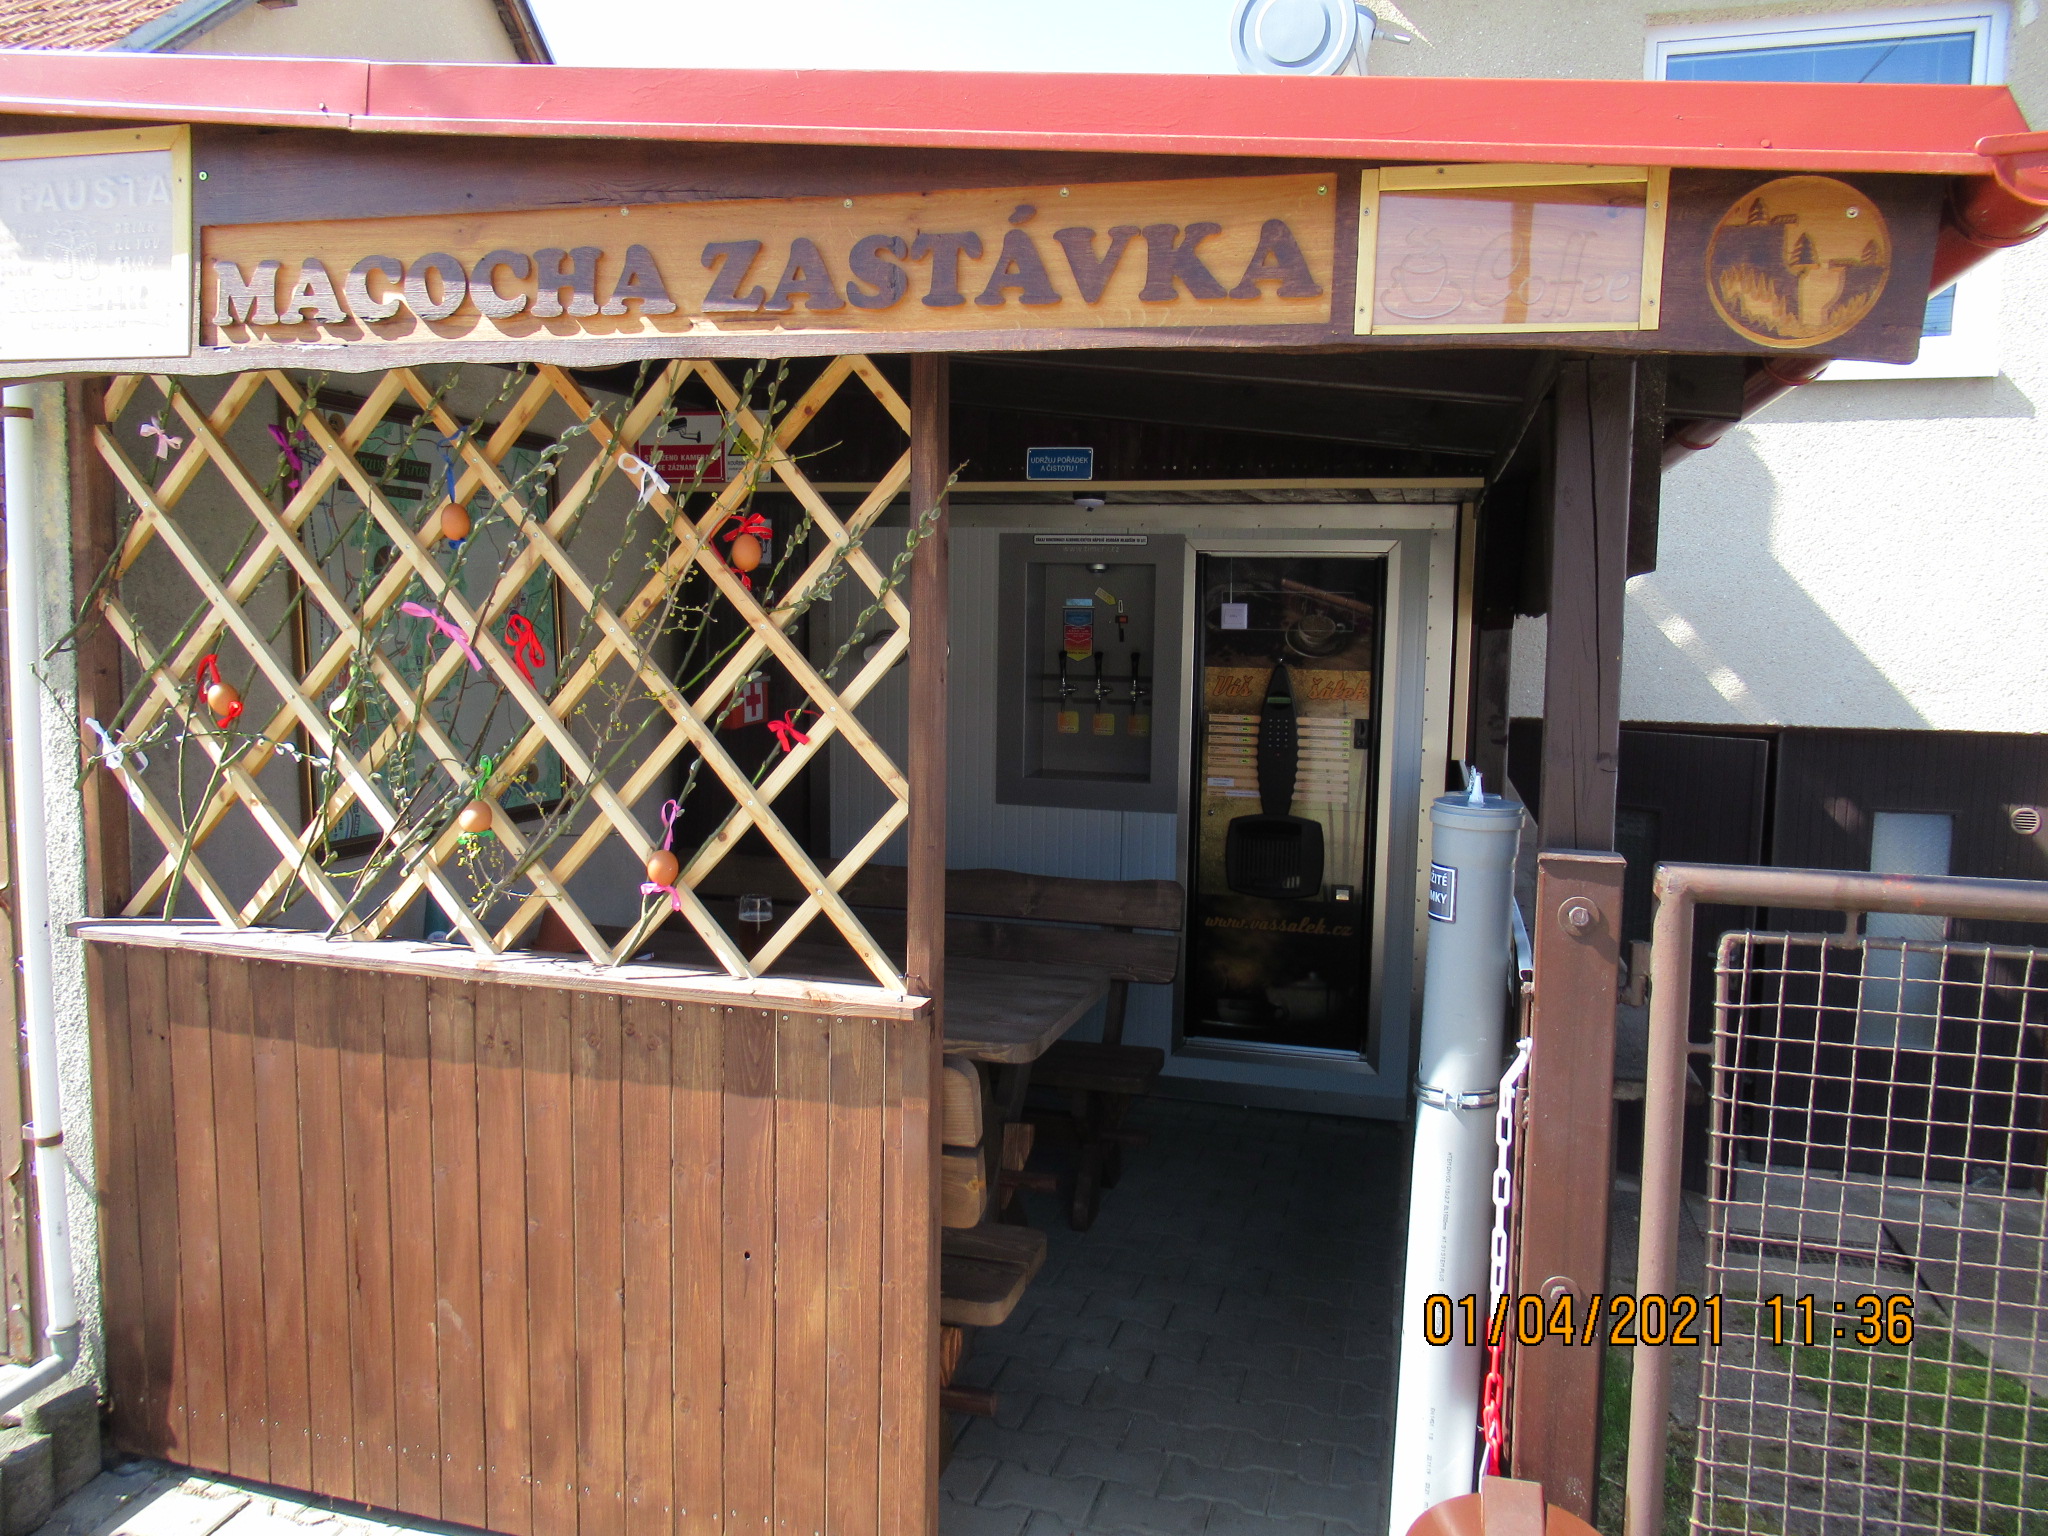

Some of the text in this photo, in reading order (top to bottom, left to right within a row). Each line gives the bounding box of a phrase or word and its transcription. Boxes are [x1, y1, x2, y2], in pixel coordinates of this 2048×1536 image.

[211, 204, 1324, 327] MACOCHA ZASTÁVKA
[1472, 230, 1632, 319] Coffee
[1030, 455, 1089, 464] UDRŽUJ POŘÁDEK
[1040, 464, 1046, 472] A
[1046, 463, 1075, 472] ČISTOTU
[1213, 674, 1253, 697] Váš
[1205, 915, 1354, 937] www.vassalek.cz
